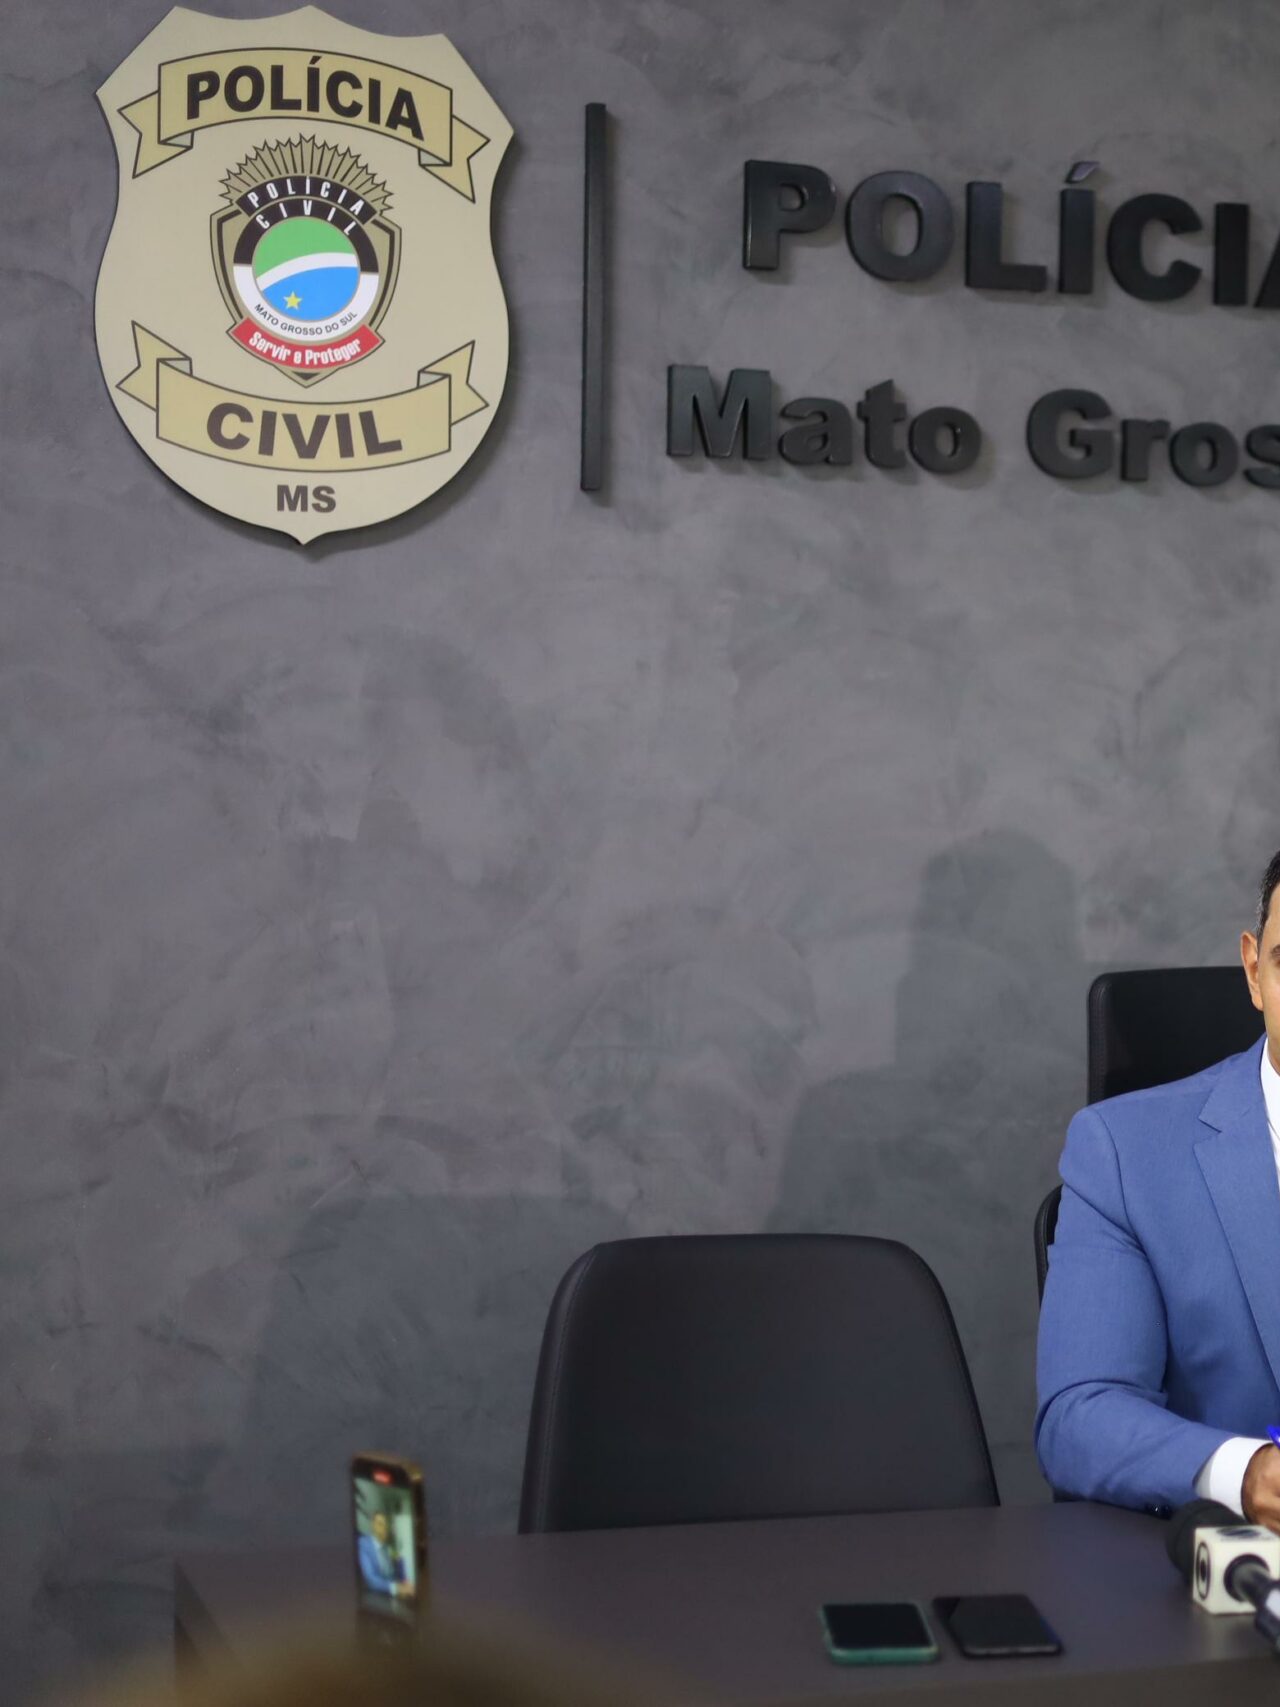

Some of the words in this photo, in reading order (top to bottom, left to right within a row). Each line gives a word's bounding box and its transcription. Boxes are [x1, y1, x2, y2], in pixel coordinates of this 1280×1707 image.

[186, 55, 425, 141] POLÍCIA
[256, 200, 358, 236] CIVIL
[254, 303, 279, 326] MATO
[280, 322, 323, 335] GROSSO
[325, 321, 340, 334] DO
[340, 311, 358, 328] SUL
[249, 332, 290, 361] Servir
[293, 351, 302, 363] e
[305, 339, 361, 365] Proteger
[206, 402, 403, 460] CIVIL
[666, 364, 982, 475] Mato
[276, 485, 336, 513] MS
